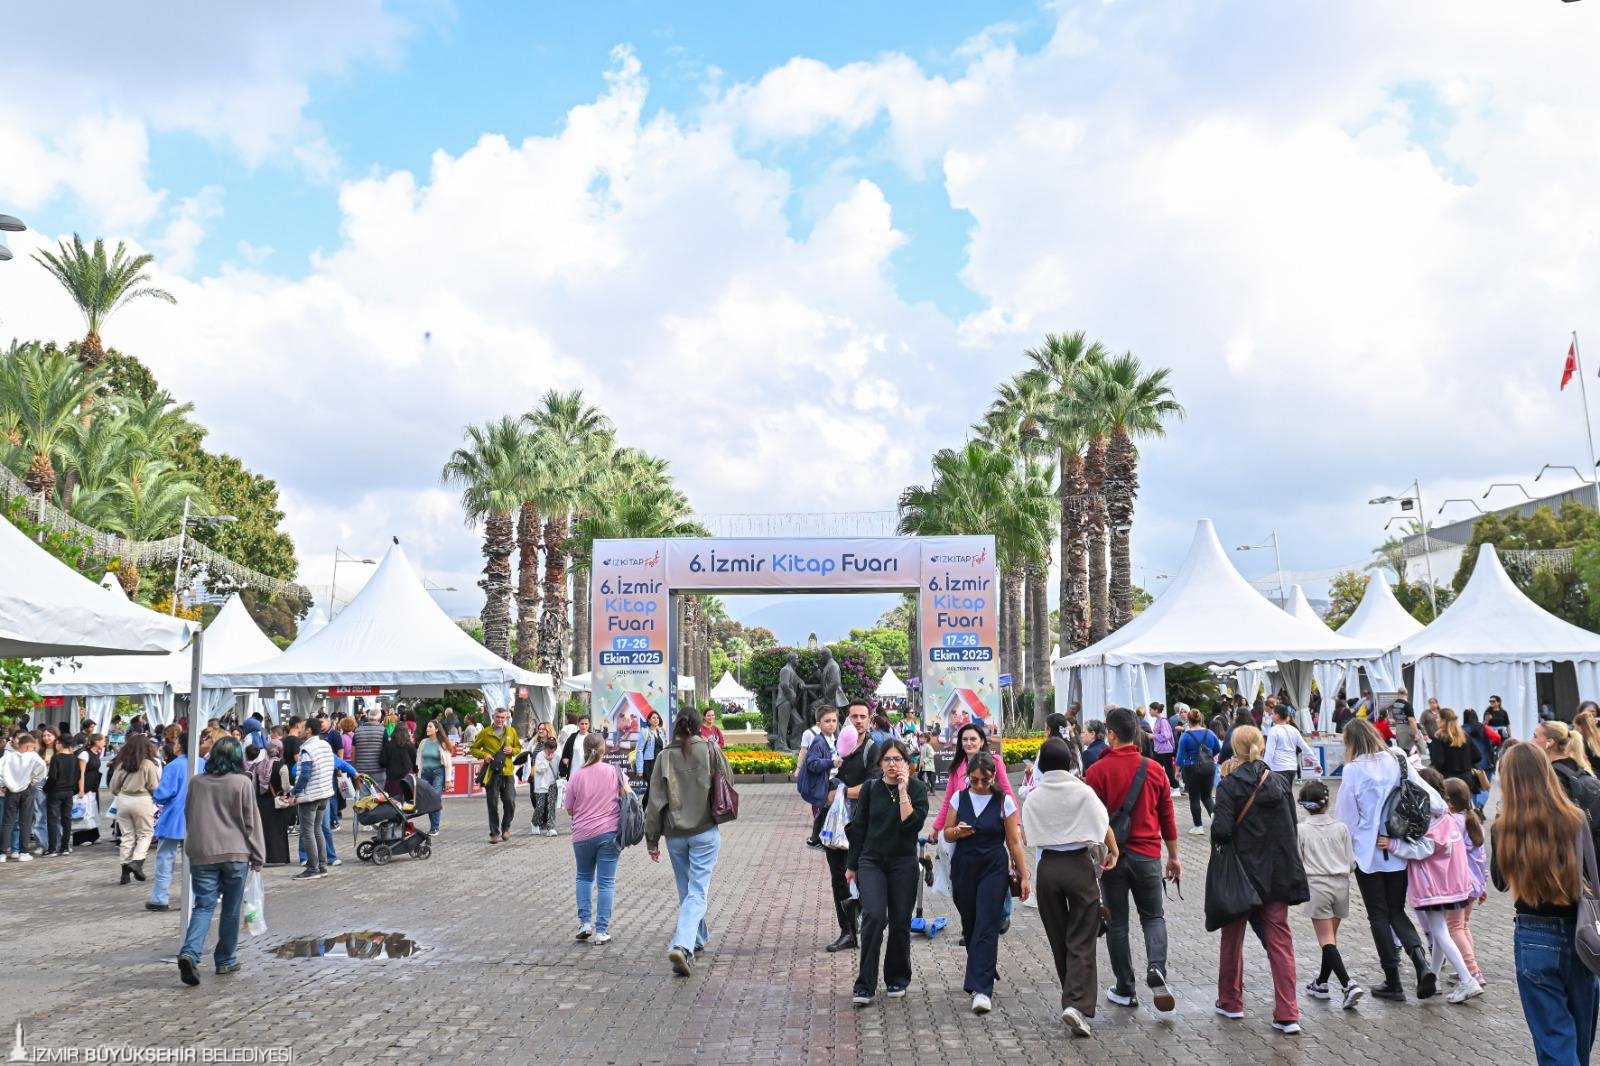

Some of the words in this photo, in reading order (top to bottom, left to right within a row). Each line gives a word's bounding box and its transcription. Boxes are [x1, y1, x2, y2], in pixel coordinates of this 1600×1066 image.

[689, 554, 705, 573] 6.
[711, 550, 765, 572] İzmir
[772, 554, 835, 576] Kitap
[842, 554, 898, 572] Fuarı
[600, 580, 614, 595] 6.
[618, 576, 662, 594] İzmir
[928, 576, 942, 592] 6.
[945, 572, 990, 591] İzmir
[605, 598, 657, 616] Kitap
[933, 595, 986, 613] Kitap
[608, 616, 654, 631] Fuarı
[937, 613, 983, 628] Fuarı
[616, 639, 647, 649] 17-26
[945, 635, 977, 646] 17-26
[603, 653, 629, 664] Ekim
[632, 653, 660, 663] 2025
[933, 650, 960, 660] Ekim
[962, 649, 990, 660] 2025
